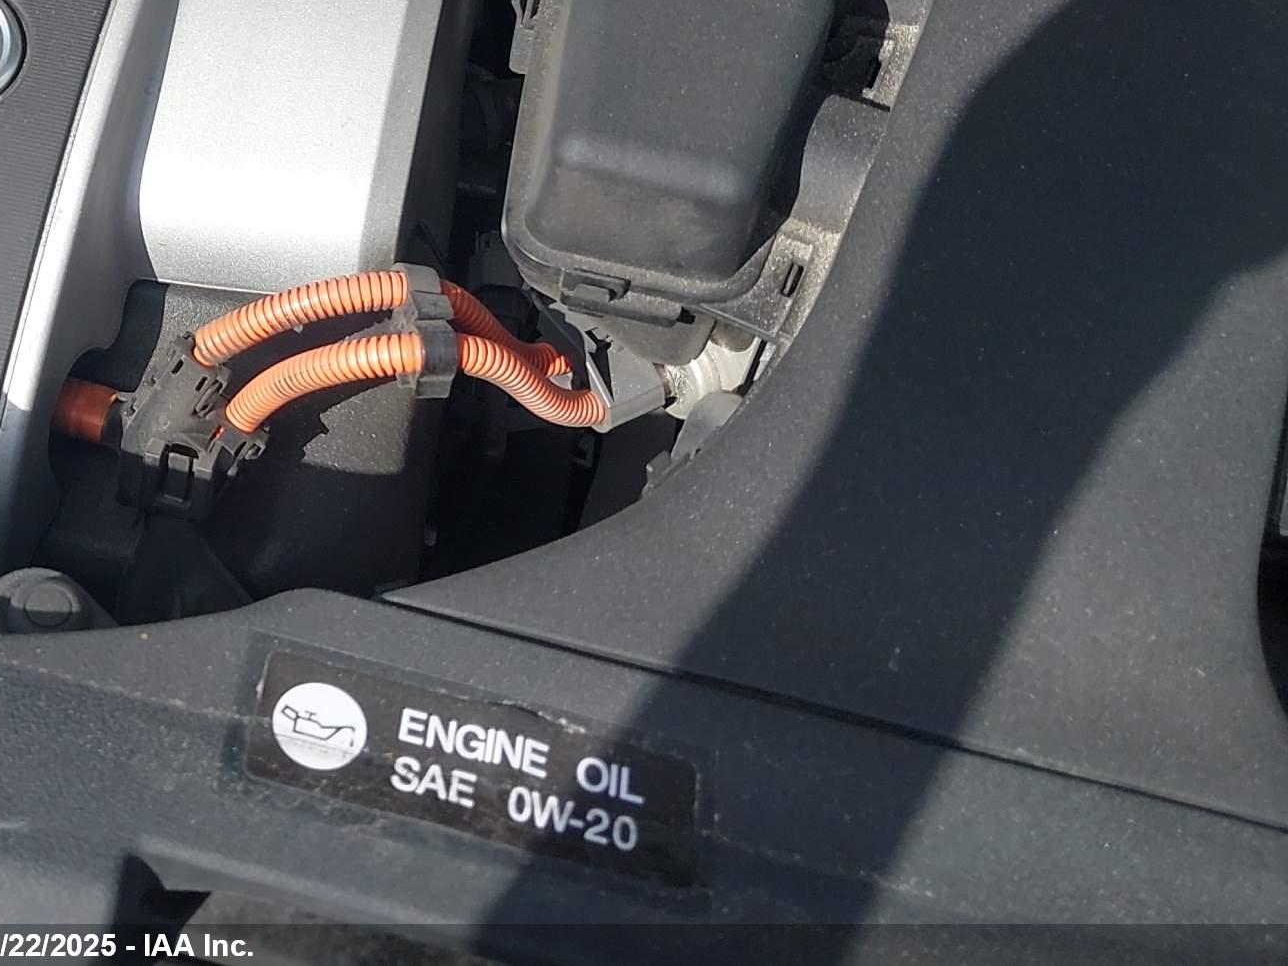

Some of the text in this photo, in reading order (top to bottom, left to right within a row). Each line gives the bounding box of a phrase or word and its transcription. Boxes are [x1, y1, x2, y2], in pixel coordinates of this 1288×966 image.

[390, 756, 639, 852] SAE 0W-20
[397, 707, 645, 806] ENGINE OIL
